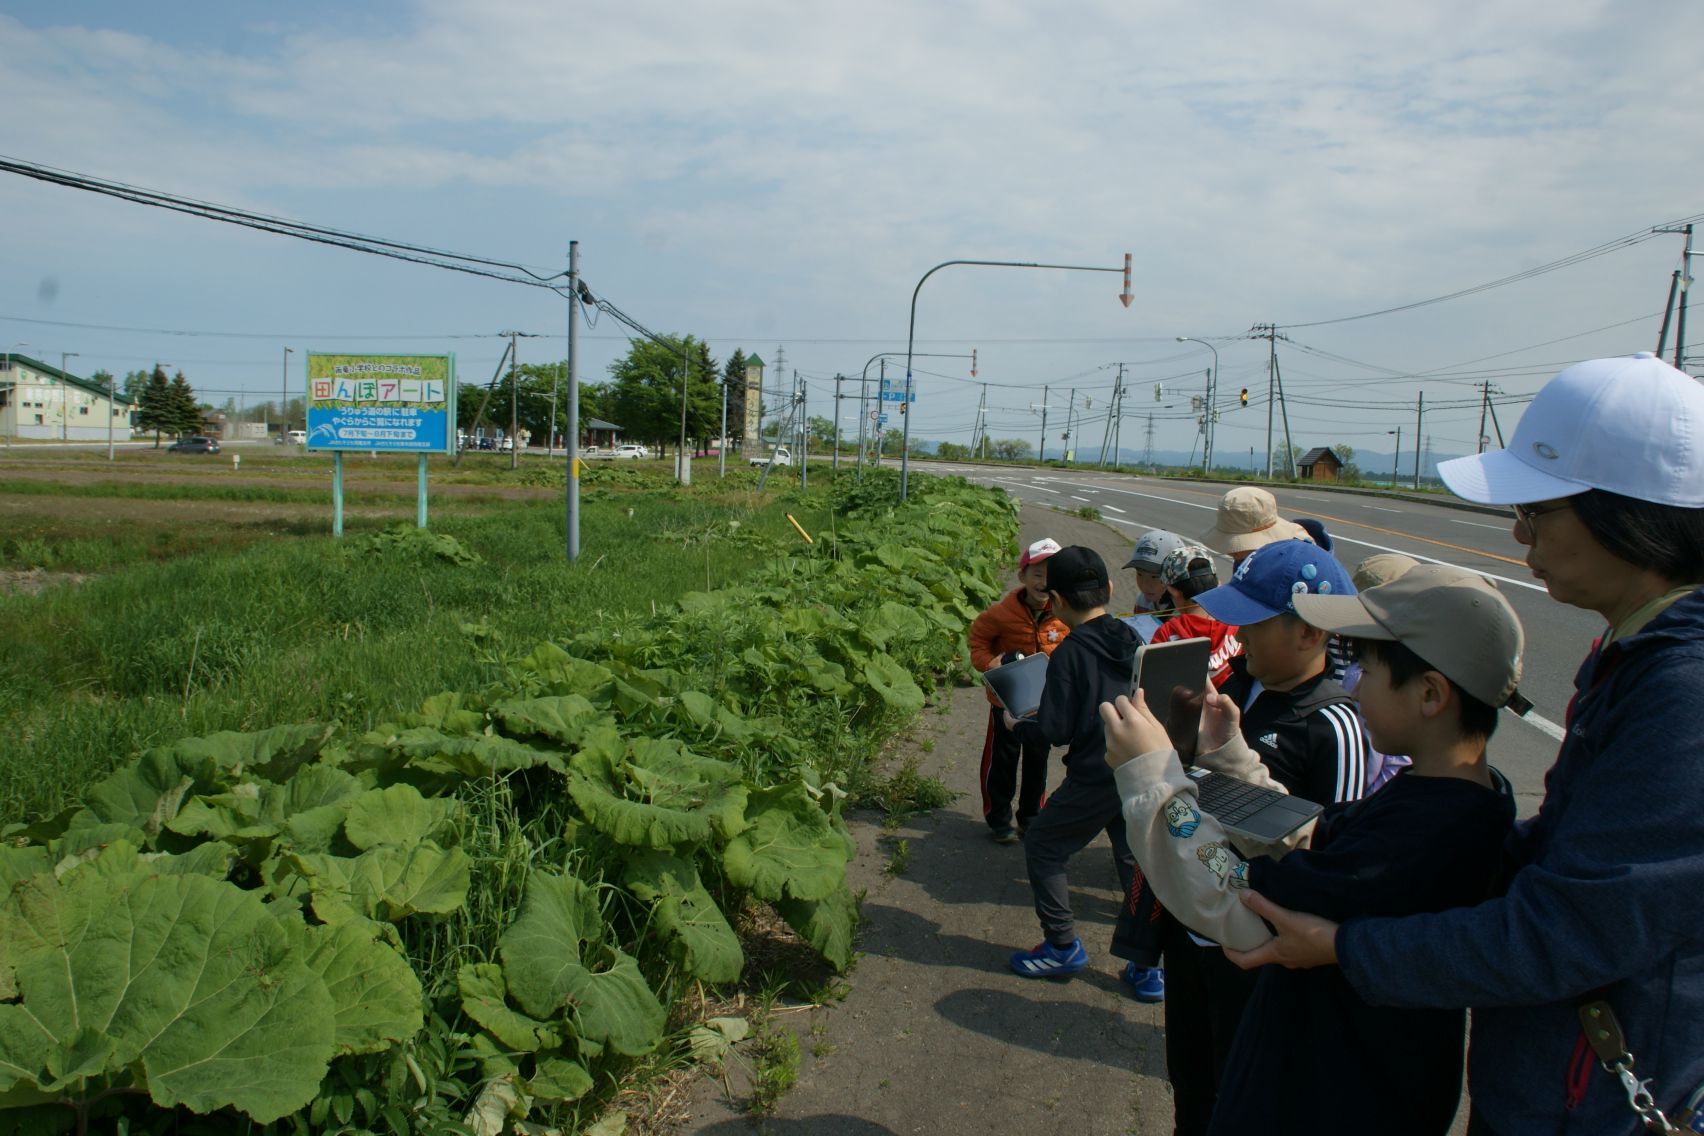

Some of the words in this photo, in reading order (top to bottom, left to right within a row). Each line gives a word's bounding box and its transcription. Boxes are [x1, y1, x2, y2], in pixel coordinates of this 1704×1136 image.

[315, 381, 441, 400] 田んぼアート
[1259, 736, 1278, 749] adidas
